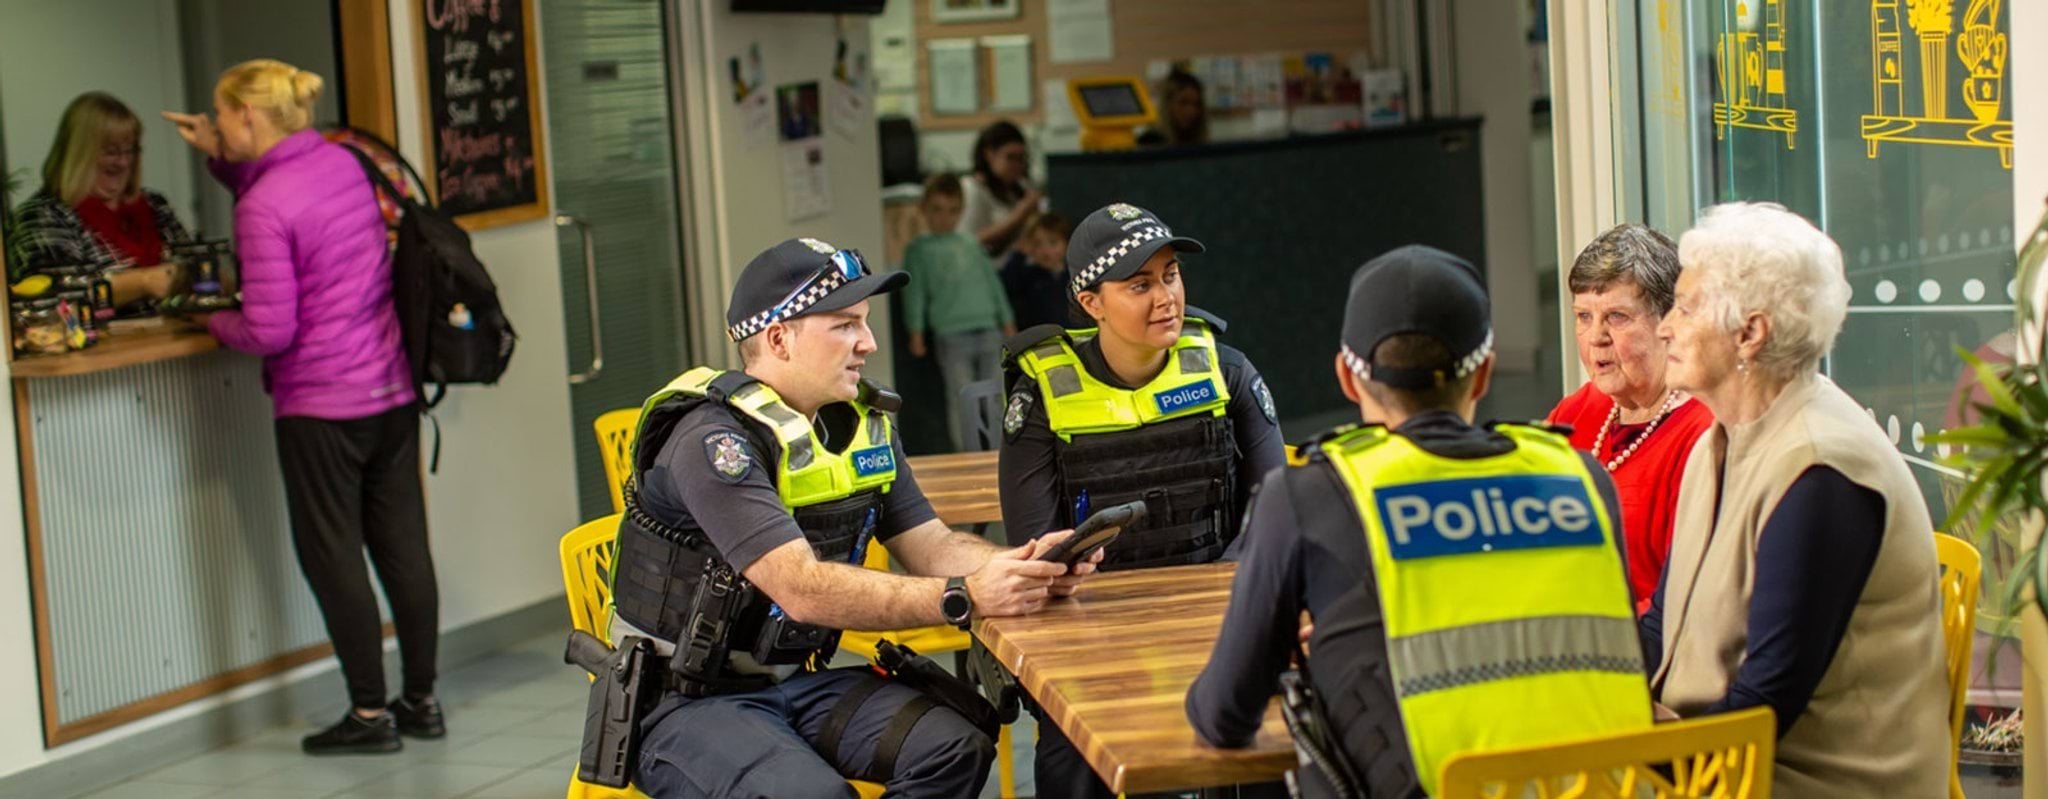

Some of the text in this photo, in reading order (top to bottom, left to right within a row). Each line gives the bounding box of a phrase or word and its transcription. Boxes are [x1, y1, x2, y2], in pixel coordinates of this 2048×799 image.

[1161, 387, 1210, 408] Police
[857, 453, 890, 470] Police
[1385, 487, 1592, 545] Police
